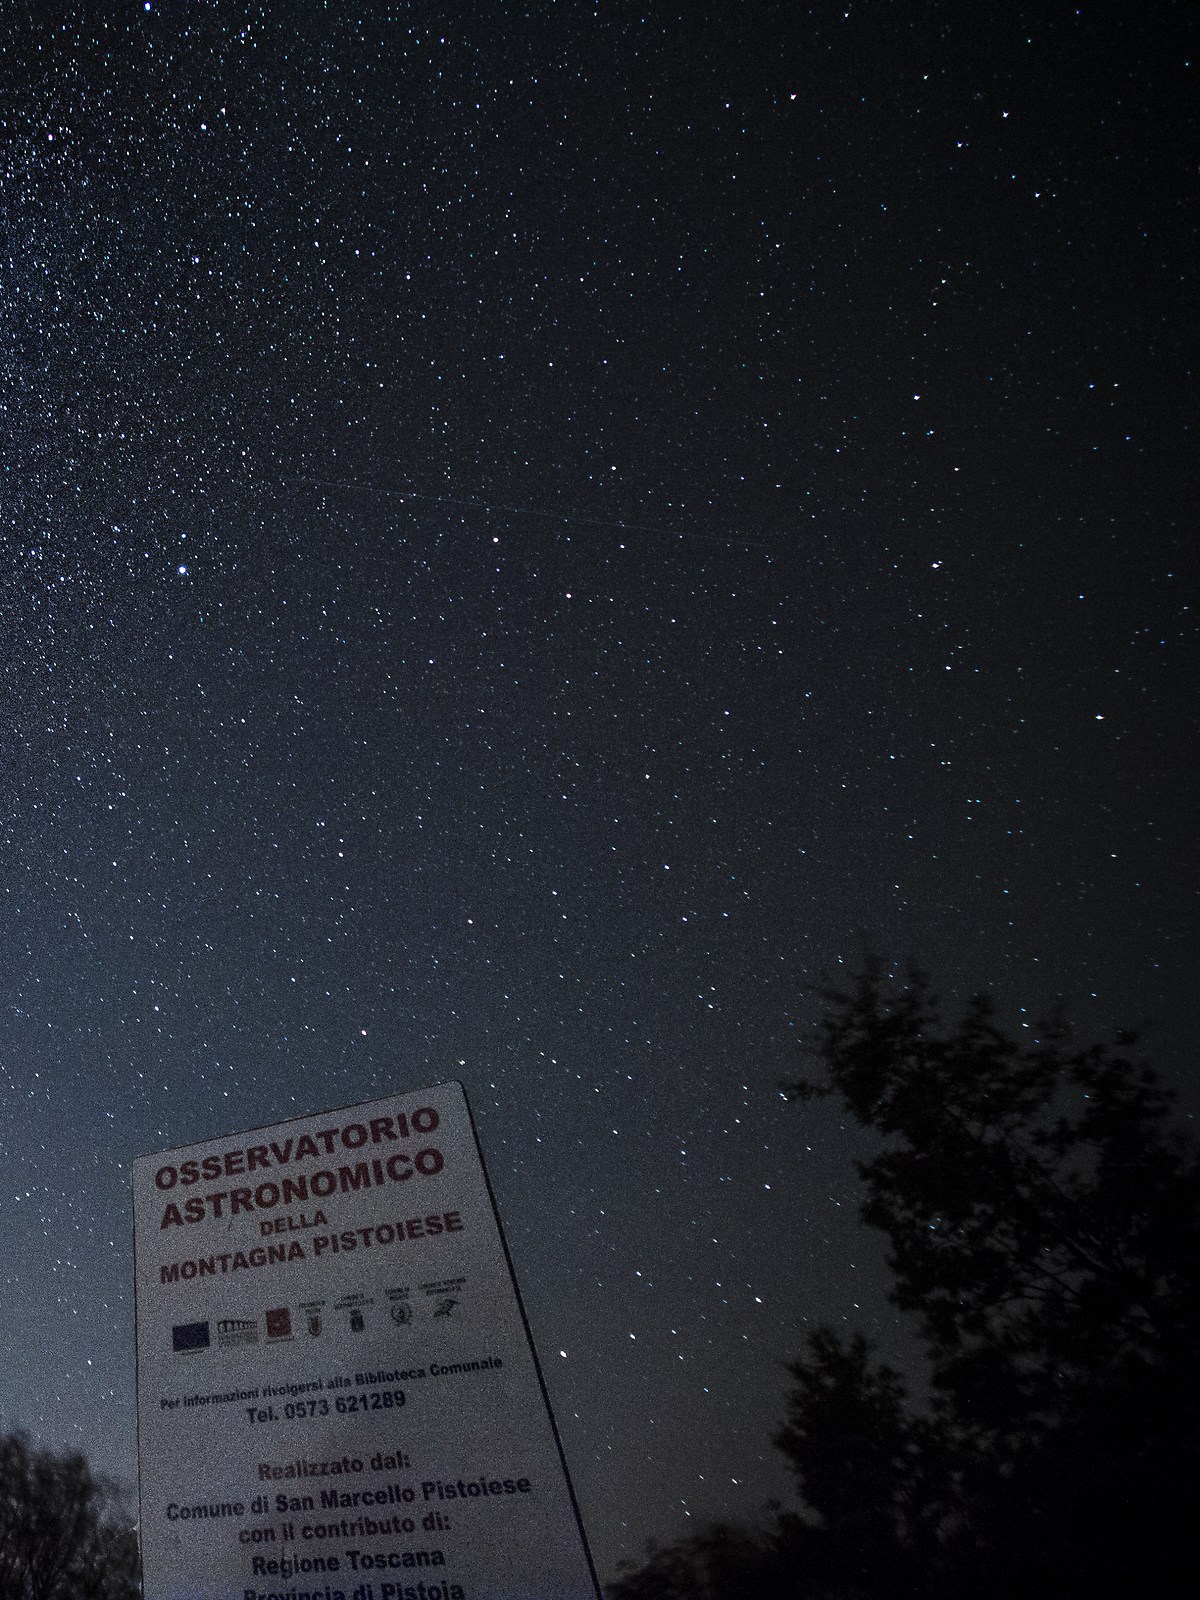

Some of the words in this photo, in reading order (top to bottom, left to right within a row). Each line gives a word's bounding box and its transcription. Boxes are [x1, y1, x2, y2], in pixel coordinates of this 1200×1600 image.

[155, 1107, 440, 1190] OSSERVATORIO
[160, 1148, 445, 1229] ASTRONOMICO
[260, 1210, 328, 1236] DELLA
[160, 1242, 306, 1284] MONTAGNA
[313, 1211, 464, 1255] PISTOIESE
[160, 1396, 180, 1410] Per
[183, 1388, 259, 1407] informazioni
[262, 1378, 323, 1397] rivolgersi
[327, 1375, 352, 1390] alla
[355, 1368, 426, 1386] Biblioteca
[429, 1356, 503, 1377] Comunale
[246, 1405, 279, 1424] Tel.
[284, 1398, 330, 1420] 0573
[335, 1390, 407, 1413] 621289
[258, 1456, 364, 1481] Realizzato
[370, 1450, 411, 1471] dal:
[166, 1501, 245, 1521] Comune
[251, 1495, 270, 1514] di
[275, 1493, 315, 1513] San
[320, 1484, 415, 1509] Marcello
[421, 1476, 532, 1501] Pistoiese
[238, 1529, 276, 1544] con
[282, 1522, 295, 1541] il
[301, 1515, 415, 1540] contributo
[421, 1511, 452, 1532] di:
[252, 1554, 340, 1579] Regione
[345, 1549, 446, 1571] Toscana
